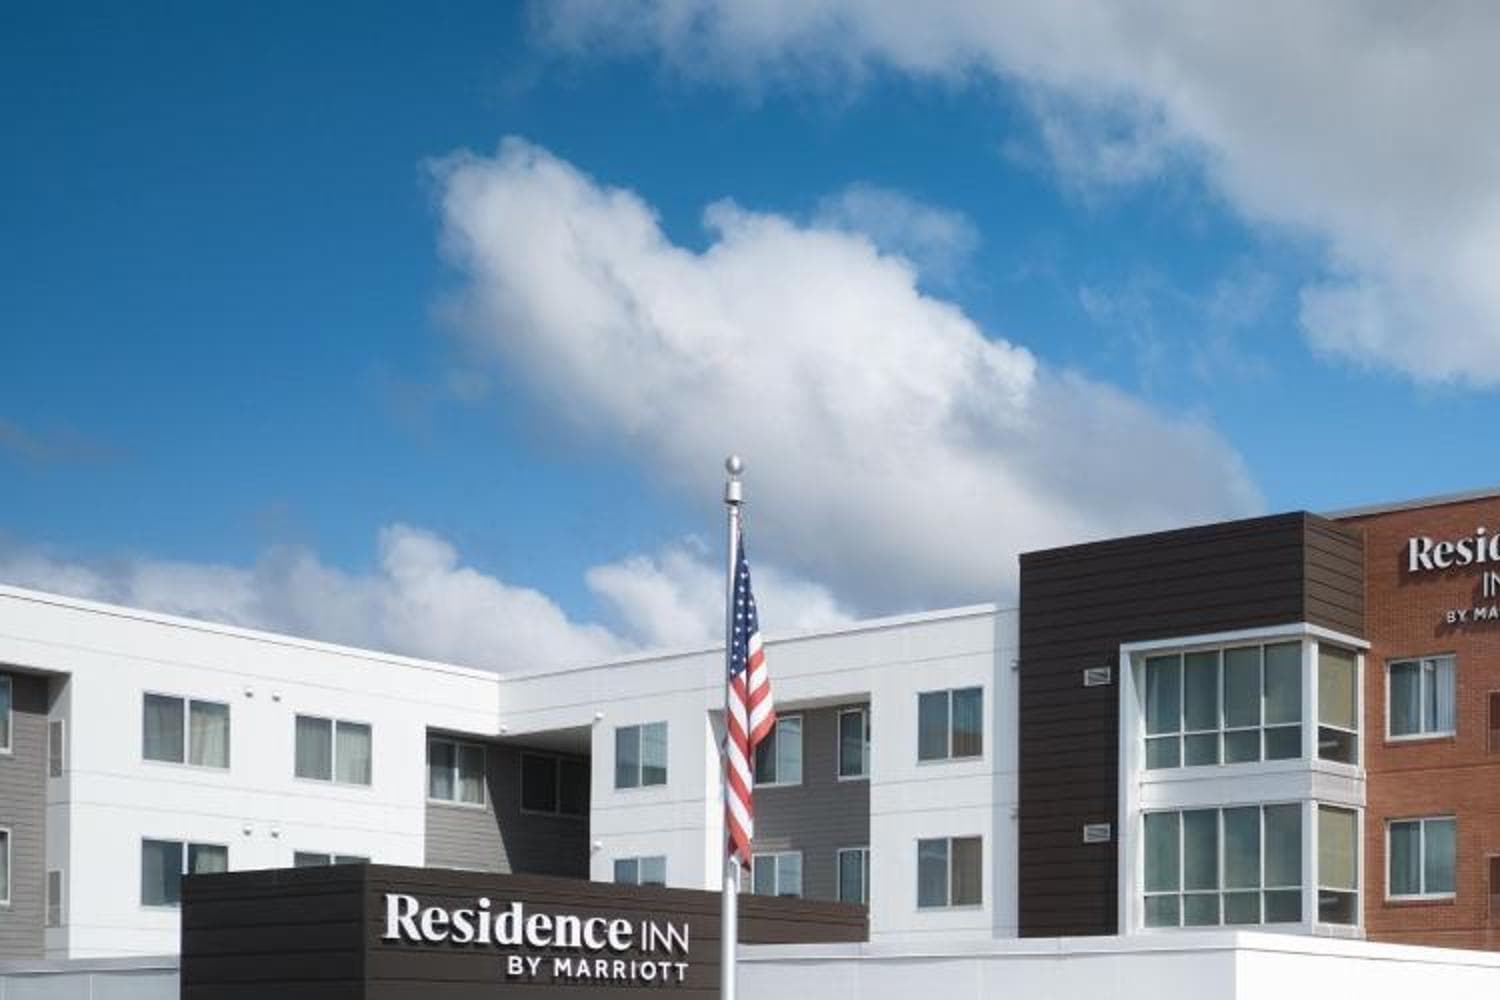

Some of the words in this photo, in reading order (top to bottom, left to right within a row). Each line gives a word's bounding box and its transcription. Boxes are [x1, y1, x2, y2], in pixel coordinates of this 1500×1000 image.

[1447, 611, 1467, 623] BY
[383, 893, 633, 950] Residence
[641, 920, 689, 954] INN
[508, 956, 541, 976] BY
[554, 957, 689, 982] MARRIOTT
